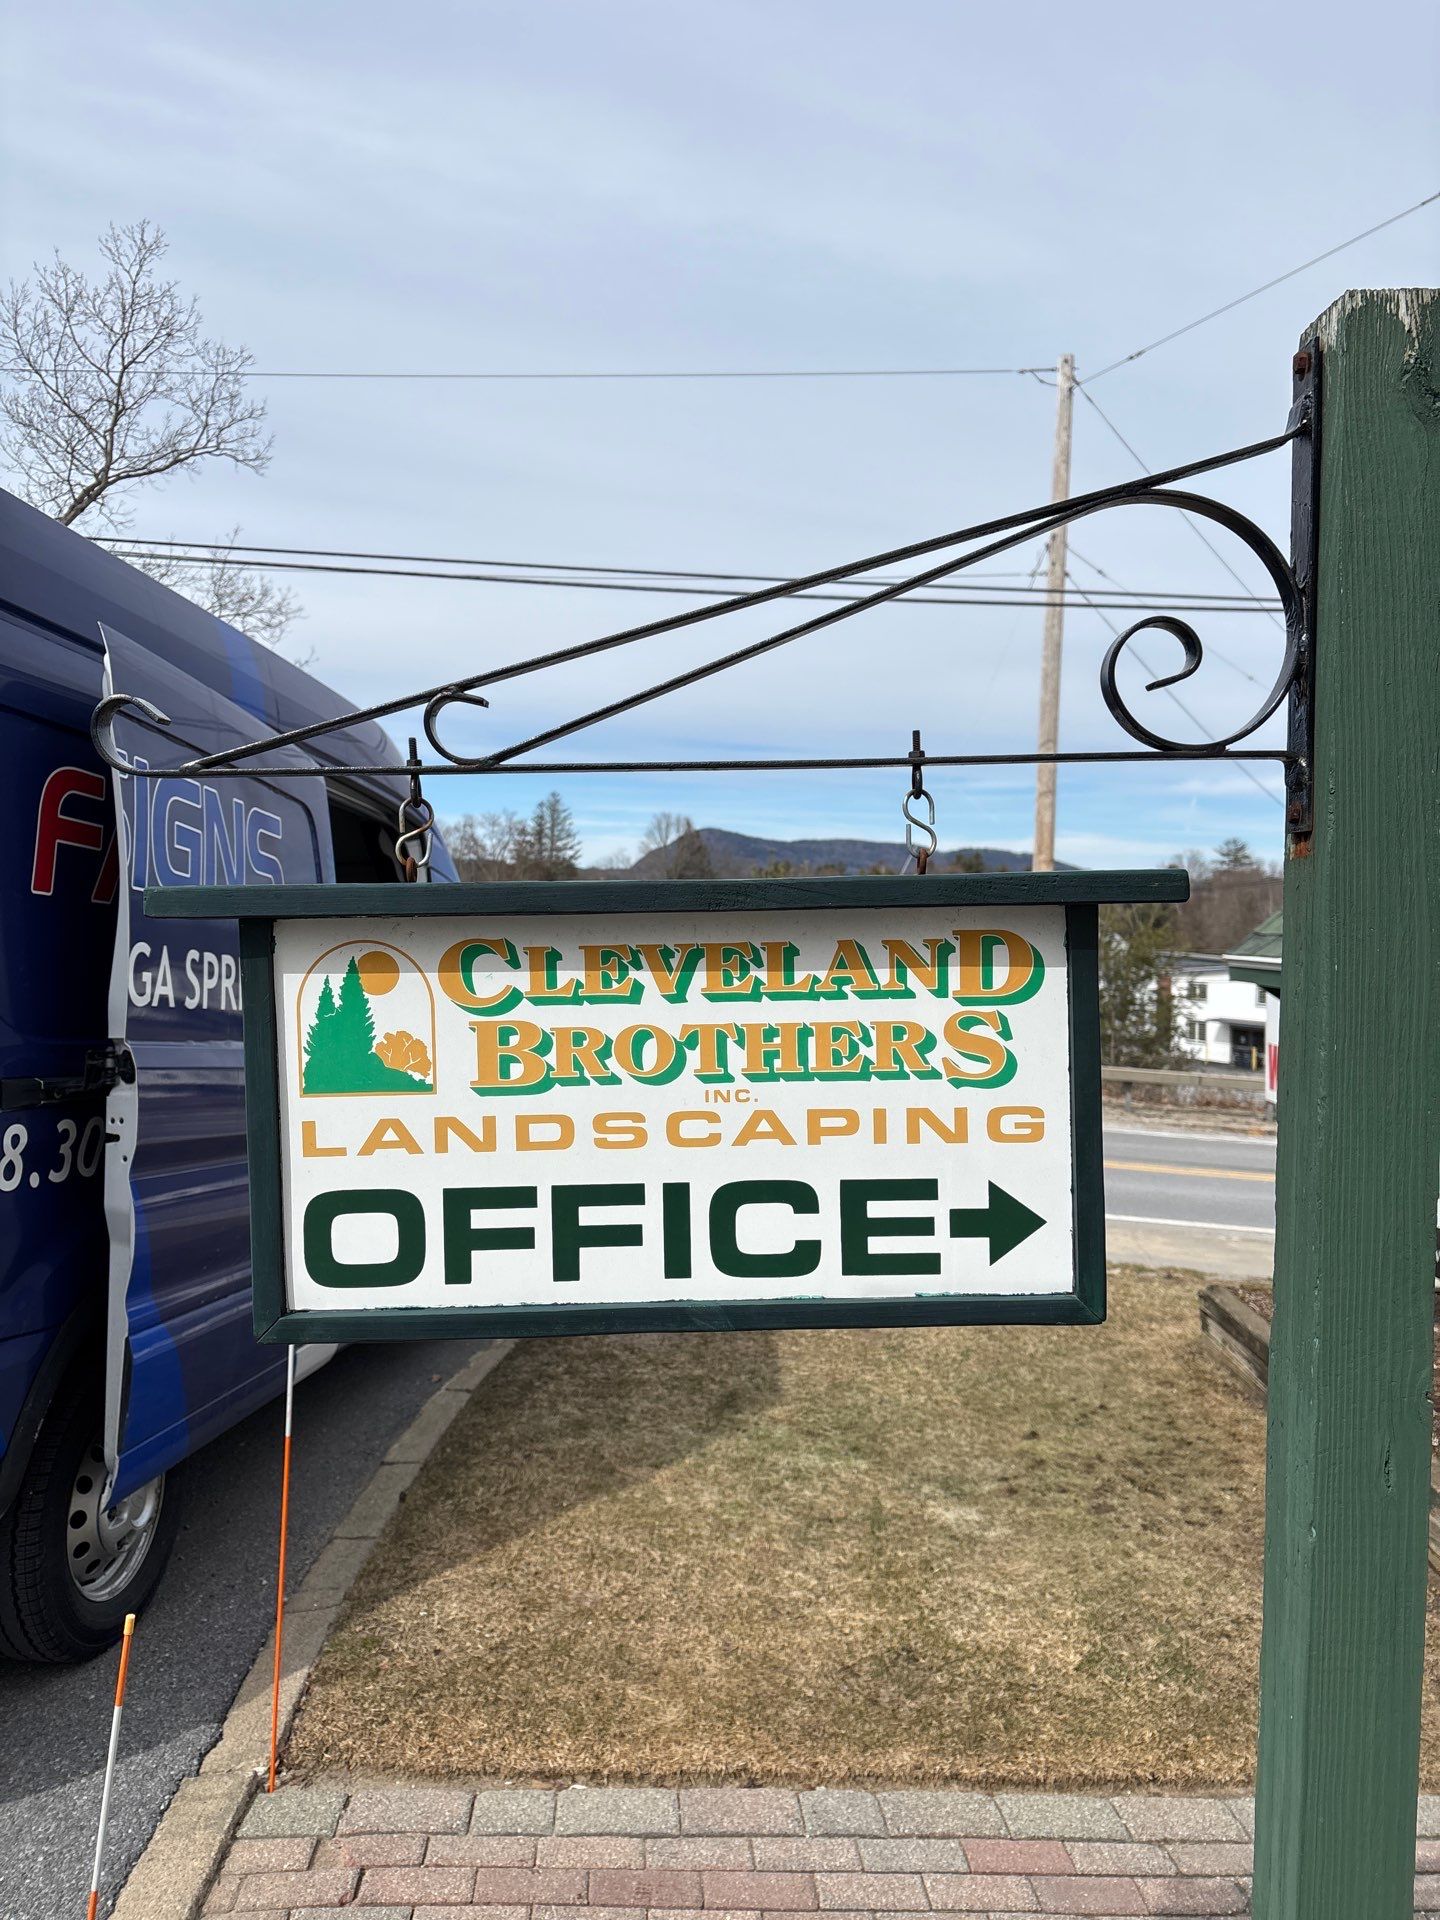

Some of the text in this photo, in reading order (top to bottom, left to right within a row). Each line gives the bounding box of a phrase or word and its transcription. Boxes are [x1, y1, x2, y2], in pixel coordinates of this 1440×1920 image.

[116, 748, 285, 892] IGNS
[437, 929, 1046, 1017] CLEVELAND
[467, 1010, 1018, 1097] BROTHERS
[705, 1088, 758, 1104] INC.
[301, 1106, 1046, 1158] LANDSCAPING
[303, 1178, 942, 1289] OFFICE
